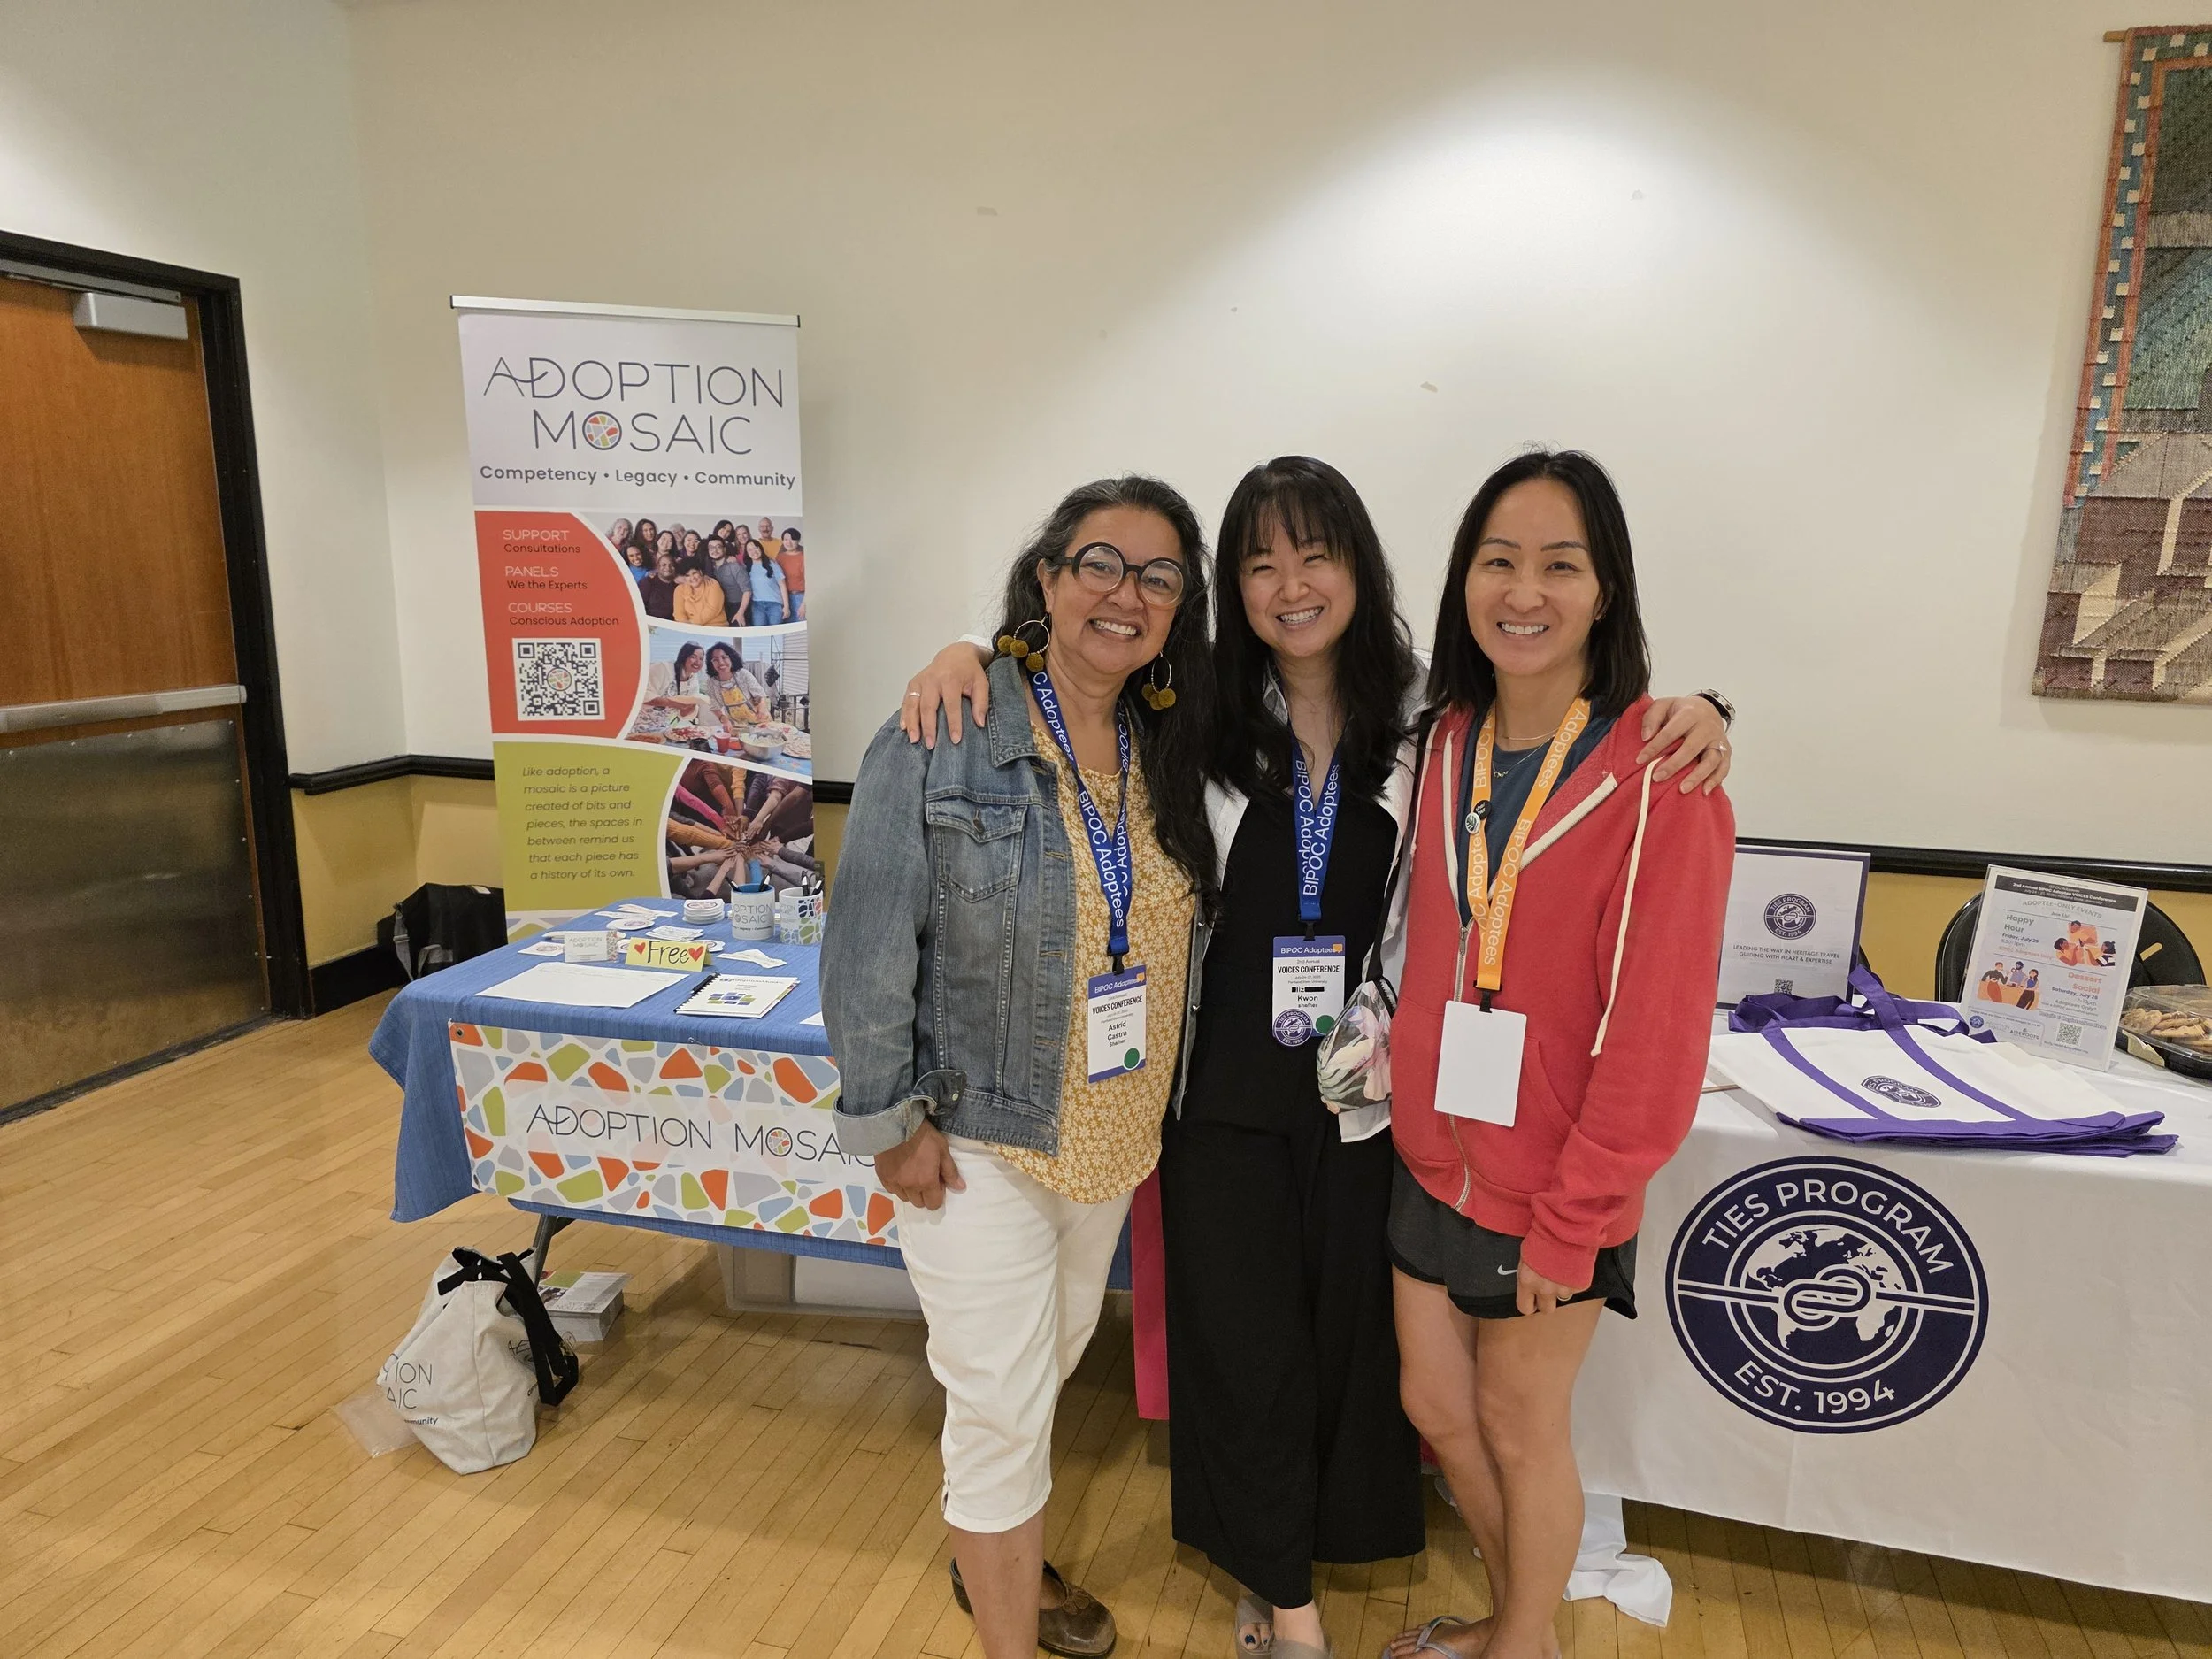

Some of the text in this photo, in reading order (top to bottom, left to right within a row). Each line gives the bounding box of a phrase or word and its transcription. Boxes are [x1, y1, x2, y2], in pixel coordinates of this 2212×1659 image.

[483, 357, 783, 407] ADOPTION
[533, 409, 752, 455] MOSAIC
[480, 465, 796, 490] Competency Legacy Community
[503, 529, 570, 541] SUPPORT
[503, 543, 581, 554] Consultations
[504, 566, 559, 577] PANELS
[507, 580, 588, 592] We the Experts
[508, 603, 573, 613] COURSES
[509, 616, 619, 628] Conscious Adoption
[1036, 685, 1074, 762] Adoptees
[1118, 724, 1129, 772] BIPOC
[1538, 708, 1587, 789] Adoptees
[1474, 733, 1491, 789] BIPOC
[523, 767, 543, 777] Like
[546, 766, 599, 778] adoption,
[524, 784, 566, 794] mosaic
[569, 784, 578, 793] is
[590, 783, 630, 795] picture
[1295, 759, 1314, 813] BIPOC
[525, 800, 631, 811] created of bits and
[526, 817, 642, 832] pieces, the spaces in
[1302, 841, 1325, 895] BIPOC
[1314, 764, 1340, 841] Adoptees
[527, 835, 576, 846] between
[580, 834, 618, 844] remind
[529, 851, 639, 864] that each piece has
[1079, 790, 1108, 845] BIPOC
[1096, 847, 1124, 928] Adoptees
[541, 870, 577, 881] history
[580, 869, 592, 879] of
[594, 869, 606, 878] its
[1484, 819, 1532, 966] BIPOC Adoptees
[1770, 896, 1812, 913] TIES PROGRAM
[733, 914, 768, 925] OSAIC
[2006, 914, 2035, 926] Happy
[2004, 924, 2024, 933] Hour
[647, 940, 689, 965] Free
[1792, 949, 1819, 957] HERITAGE
[1300, 964, 1340, 973] CONFERENCE
[2068, 972, 2102, 984] Dessert
[1094, 982, 1114, 994] BIPOC
[2051, 987, 2078, 996] Saturday,
[2072, 983, 2101, 995] Social
[1092, 1003, 1110, 1015] VOICES
[1110, 995, 1143, 1010] CONFERENCE
[1108, 1019, 1127, 1032] Astrid
[1107, 1031, 1127, 1041] Castro
[526, 1103, 876, 1168] ADOPTION MOSA
[1701, 1179, 1954, 1275] TIES PROGRAM
[1733, 1359, 1896, 1415] EST. 1994
